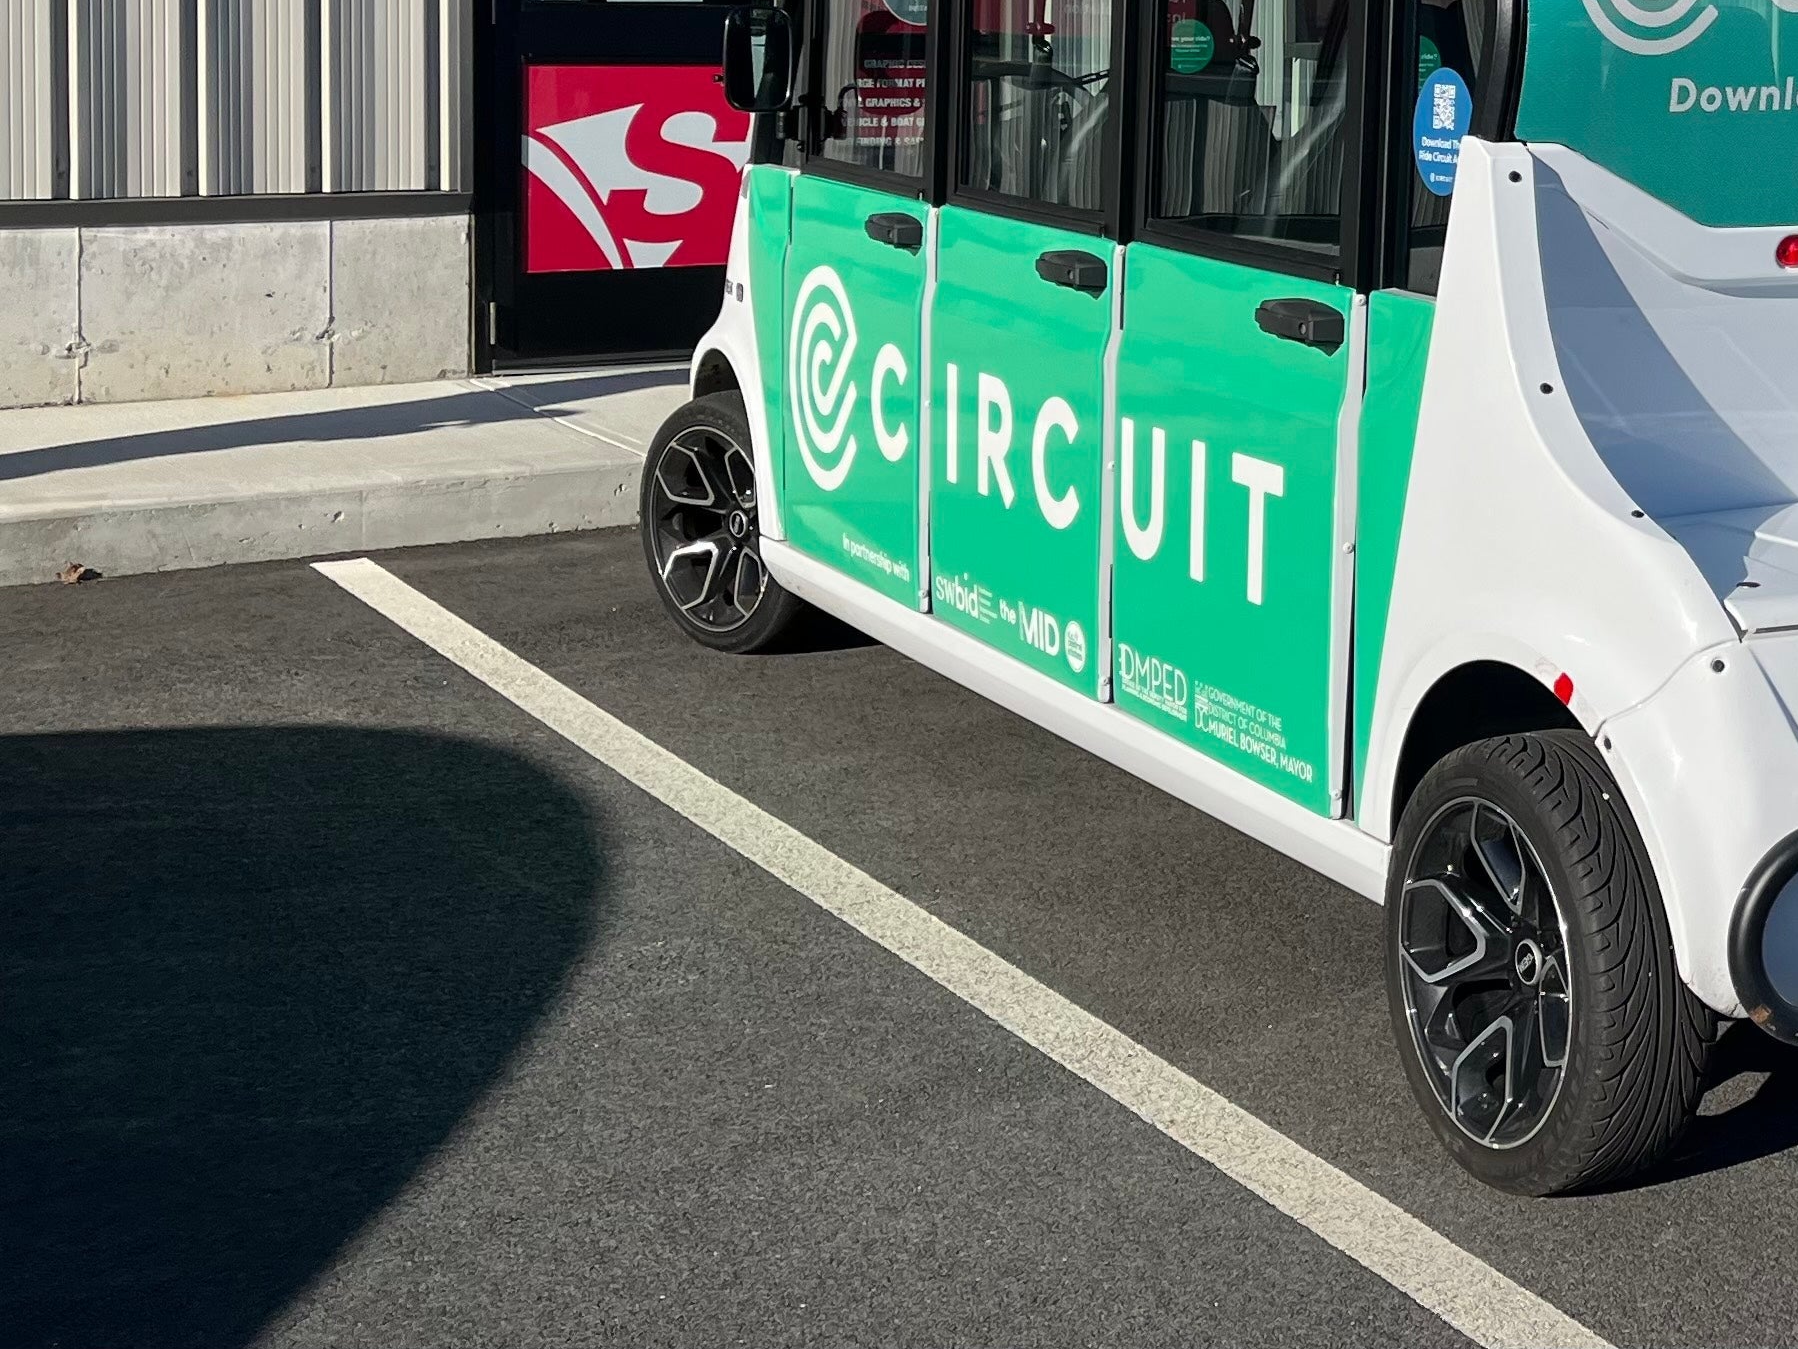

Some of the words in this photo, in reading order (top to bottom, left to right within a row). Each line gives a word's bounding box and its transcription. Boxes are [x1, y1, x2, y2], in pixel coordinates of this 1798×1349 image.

[865, 98, 911, 107] GRAPHICS
[1418, 150, 1432, 161] Ride
[1433, 151, 1453, 163] Circuit
[1421, 136, 1452, 150] Download
[870, 343, 1284, 606] CIRCUIT
[851, 542, 892, 575] partnership
[893, 561, 910, 583] with
[935, 573, 978, 619] swbid
[1000, 599, 1016, 624] the
[1018, 601, 1060, 657] MID
[1118, 643, 1188, 706] DMPED
[1208, 686, 1255, 717] GOVERNMENT
[1256, 708, 1267, 723] OF
[1267, 714, 1282, 731] THE
[1208, 702, 1236, 726] DISTRICT
[1238, 716, 1248, 729] OF
[1249, 721, 1286, 750] COLUMBIA
[1209, 719, 1239, 748] MURIEL
[1240, 733, 1278, 768] BOWSER,
[1280, 748, 1313, 783] MAYOR
